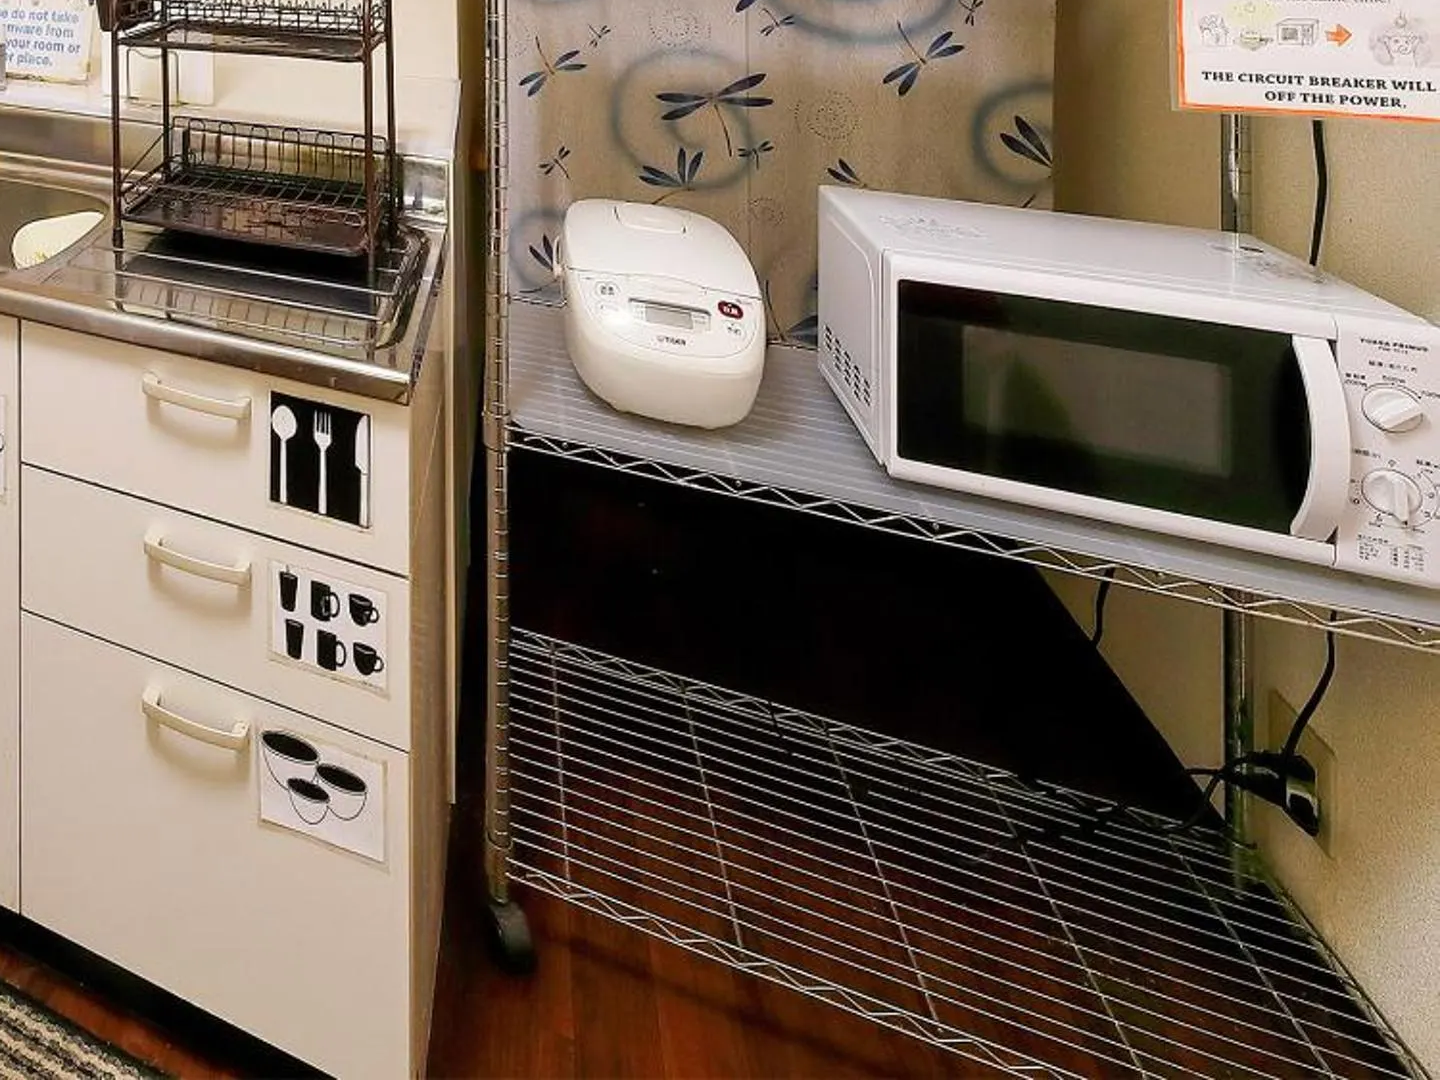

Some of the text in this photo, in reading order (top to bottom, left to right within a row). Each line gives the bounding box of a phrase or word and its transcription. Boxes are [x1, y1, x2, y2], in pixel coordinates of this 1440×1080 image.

[11, 8, 26, 20] do
[28, 9, 50, 21] not
[51, 10, 80, 24] take
[45, 23, 74, 38] from
[33, 39, 64, 52] room
[67, 43, 81, 55] or
[17, 51, 53, 66] place.
[1201, 71, 1437, 93] THE CIRCUIT BREAKER WILL
[1264, 91, 1407, 109] OFF THE POWER.
